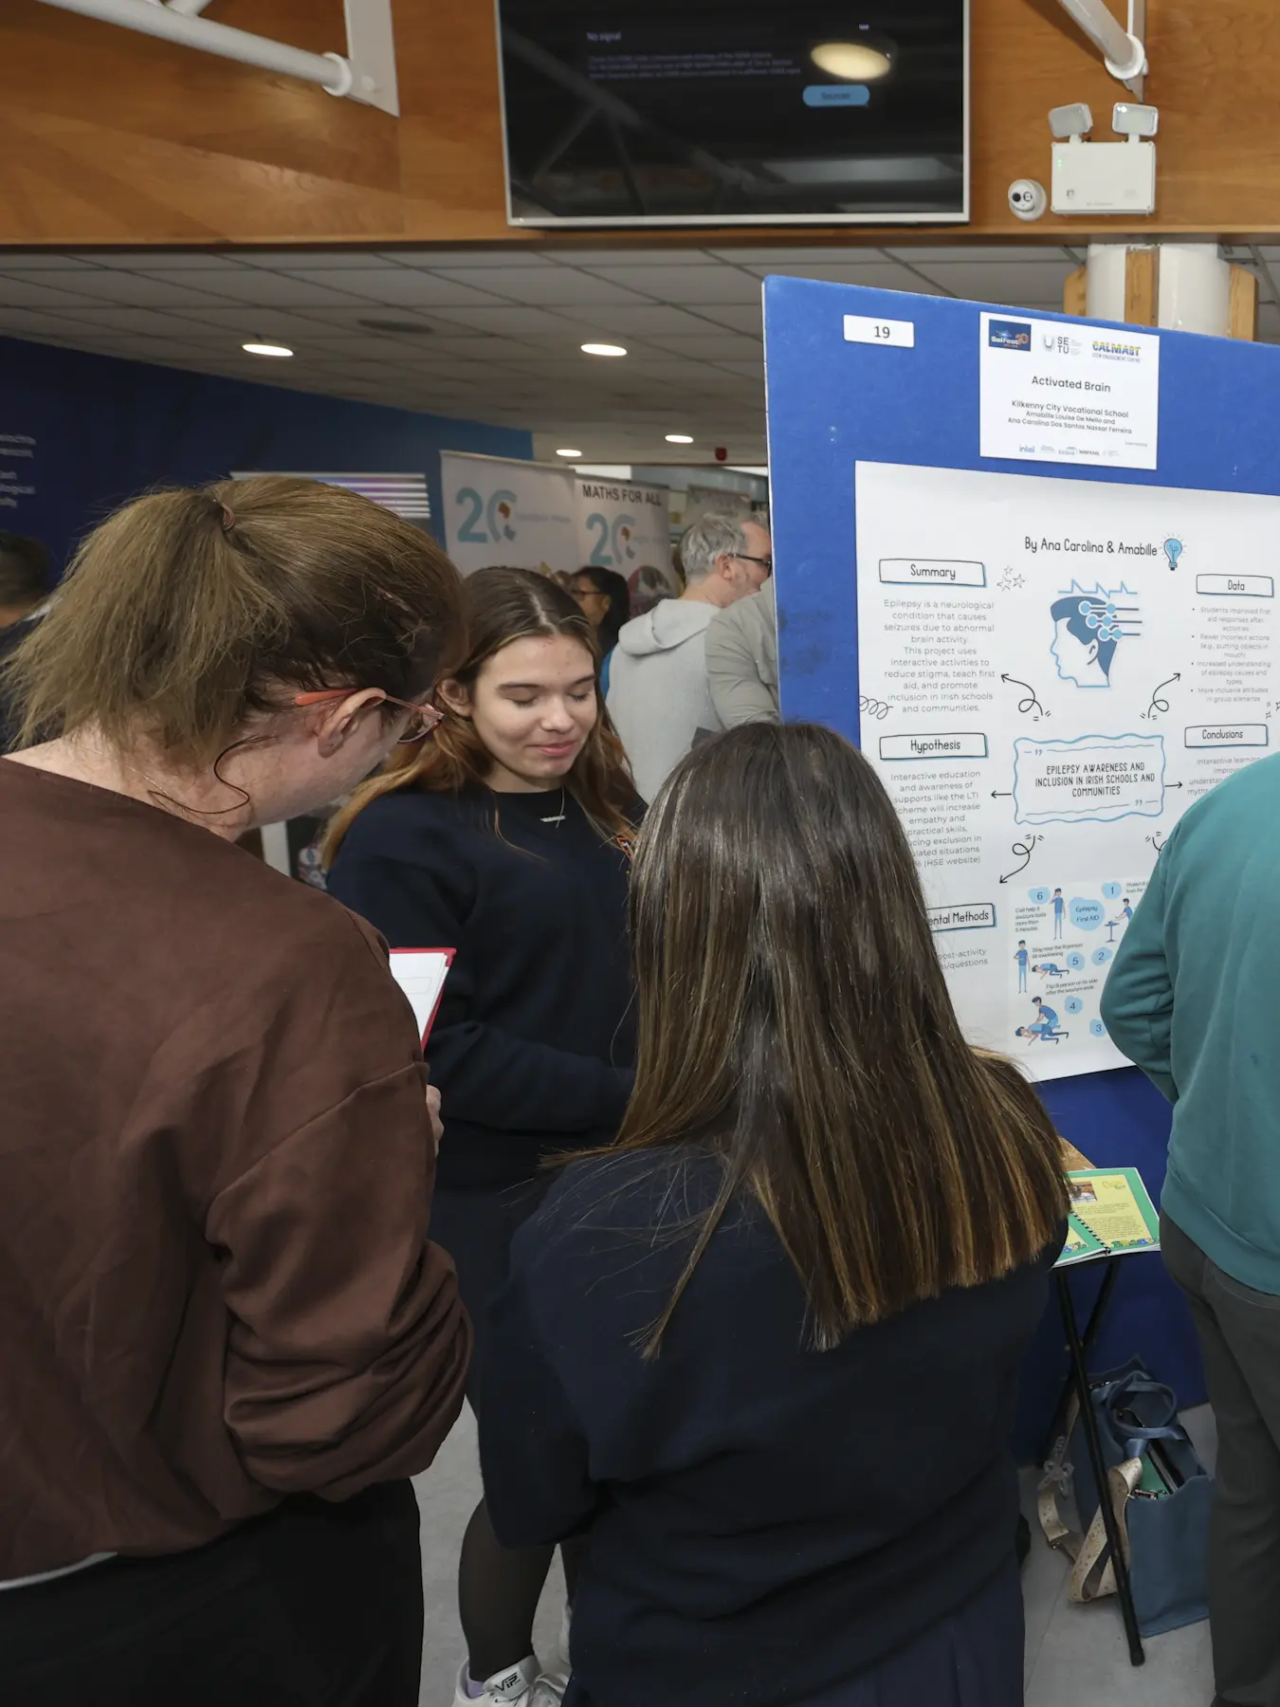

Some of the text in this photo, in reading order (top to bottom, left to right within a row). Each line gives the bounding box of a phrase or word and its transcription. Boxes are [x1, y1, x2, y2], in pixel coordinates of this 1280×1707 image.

[873, 326, 891, 339] 19
[1057, 336, 1069, 345] SE
[1058, 345, 1069, 354] TU
[1092, 341, 1141, 357] CALMAST
[1031, 376, 1111, 392] Activated Brain
[1011, 400, 1129, 418] Kilkenny City Vocational School
[1022, 418, 1049, 426] Carolina
[1064, 422, 1085, 430] Santos
[1019, 445, 1035, 453] intel
[583, 485, 662, 507] MATHS FOR ALL
[1025, 537, 1158, 556] By Ana Carolina & Amabille
[911, 564, 955, 580] Summary
[1228, 580, 1245, 590] Data
[884, 599, 921, 609] Epilepsy
[941, 601, 994, 610] neurological
[937, 612, 955, 620] that
[884, 623, 920, 631] seizures
[953, 624, 994, 632] abnormal
[903, 647, 922, 655] This
[924, 647, 955, 656] project
[885, 670, 995, 679] reduce stigma, teach first
[903, 682, 919, 690] aid,
[941, 682, 978, 690] promote
[962, 692, 993, 700] schools
[902, 705, 918, 713] and
[1202, 729, 1243, 739] Conclusions
[910, 739, 961, 754] Hypothesis
[1046, 762, 1145, 774] EPILEPSY AWARENESS AND
[891, 771, 980, 781] Interactive education
[1035, 772, 1155, 787] INCLUSION IN IRISH SCHOOLS AND
[919, 783, 962, 791] awareness
[965, 781, 973, 789] of
[1072, 786, 1120, 797] COMMUNITIES
[894, 793, 931, 803] supports
[934, 792, 949, 801] like
[951, 792, 964, 800] the
[909, 814, 965, 824] empathy and
[908, 826, 943, 836] practical
[933, 836, 971, 844] exclusion
[940, 846, 979, 855] situations
[924, 858, 943, 868] (HSE
[1037, 892, 1043, 900] 6
[953, 910, 989, 922] Methods
[1073, 957, 1078, 965] 5
[1098, 952, 1105, 960] 2
[1096, 1024, 1102, 1032] 3
